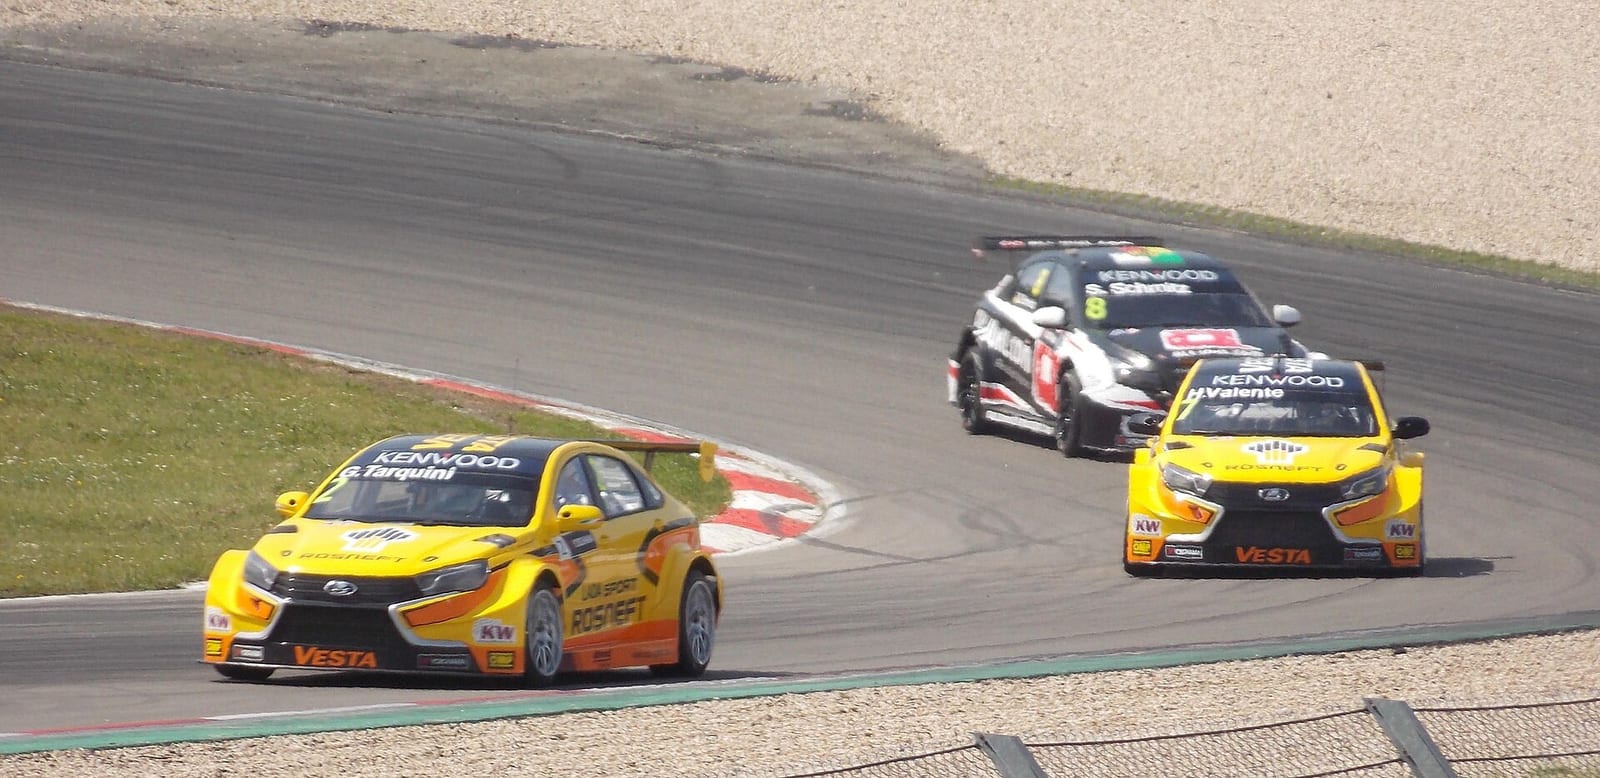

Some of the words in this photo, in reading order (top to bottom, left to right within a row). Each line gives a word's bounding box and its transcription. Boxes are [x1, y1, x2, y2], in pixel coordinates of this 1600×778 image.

[1098, 269, 1219, 281] KENWOOD
[1109, 282, 1193, 296] Schmitz
[1085, 296, 1107, 320] 8
[1212, 374, 1345, 388] KENWOOD
[373, 451, 520, 469] KENWOOD
[313, 477, 348, 503] 2
[1136, 519, 1160, 533] KW
[1390, 524, 1415, 537] KW
[1236, 546, 1312, 564] VESTA
[571, 595, 647, 635] ROSNEFT
[481, 625, 513, 640] KW
[294, 646, 378, 668] VESTA
